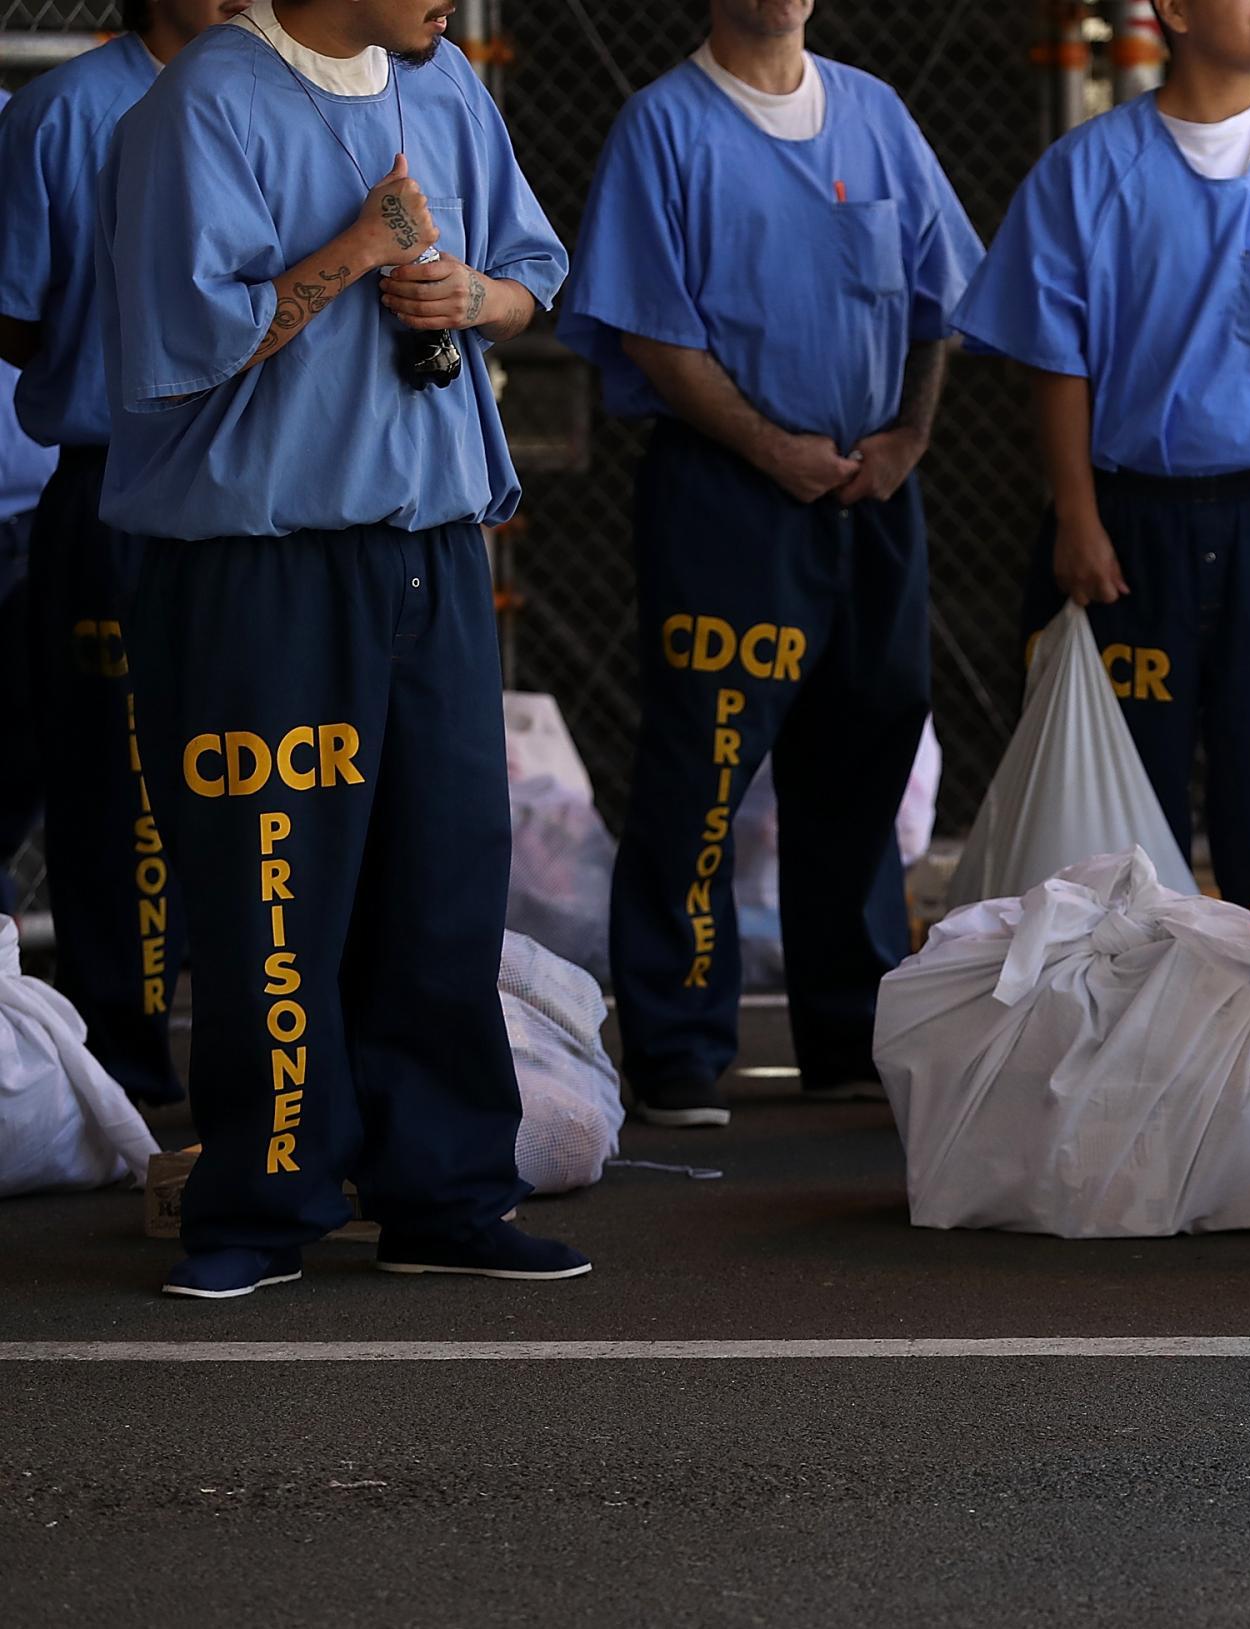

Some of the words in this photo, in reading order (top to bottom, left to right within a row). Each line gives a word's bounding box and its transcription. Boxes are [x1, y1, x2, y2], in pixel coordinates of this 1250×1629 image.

[664, 615, 806, 681] CDCR
[183, 723, 365, 797] CDCR
[684, 689, 745, 987] PRISONER
[260, 812, 306, 1174] PRISONER
